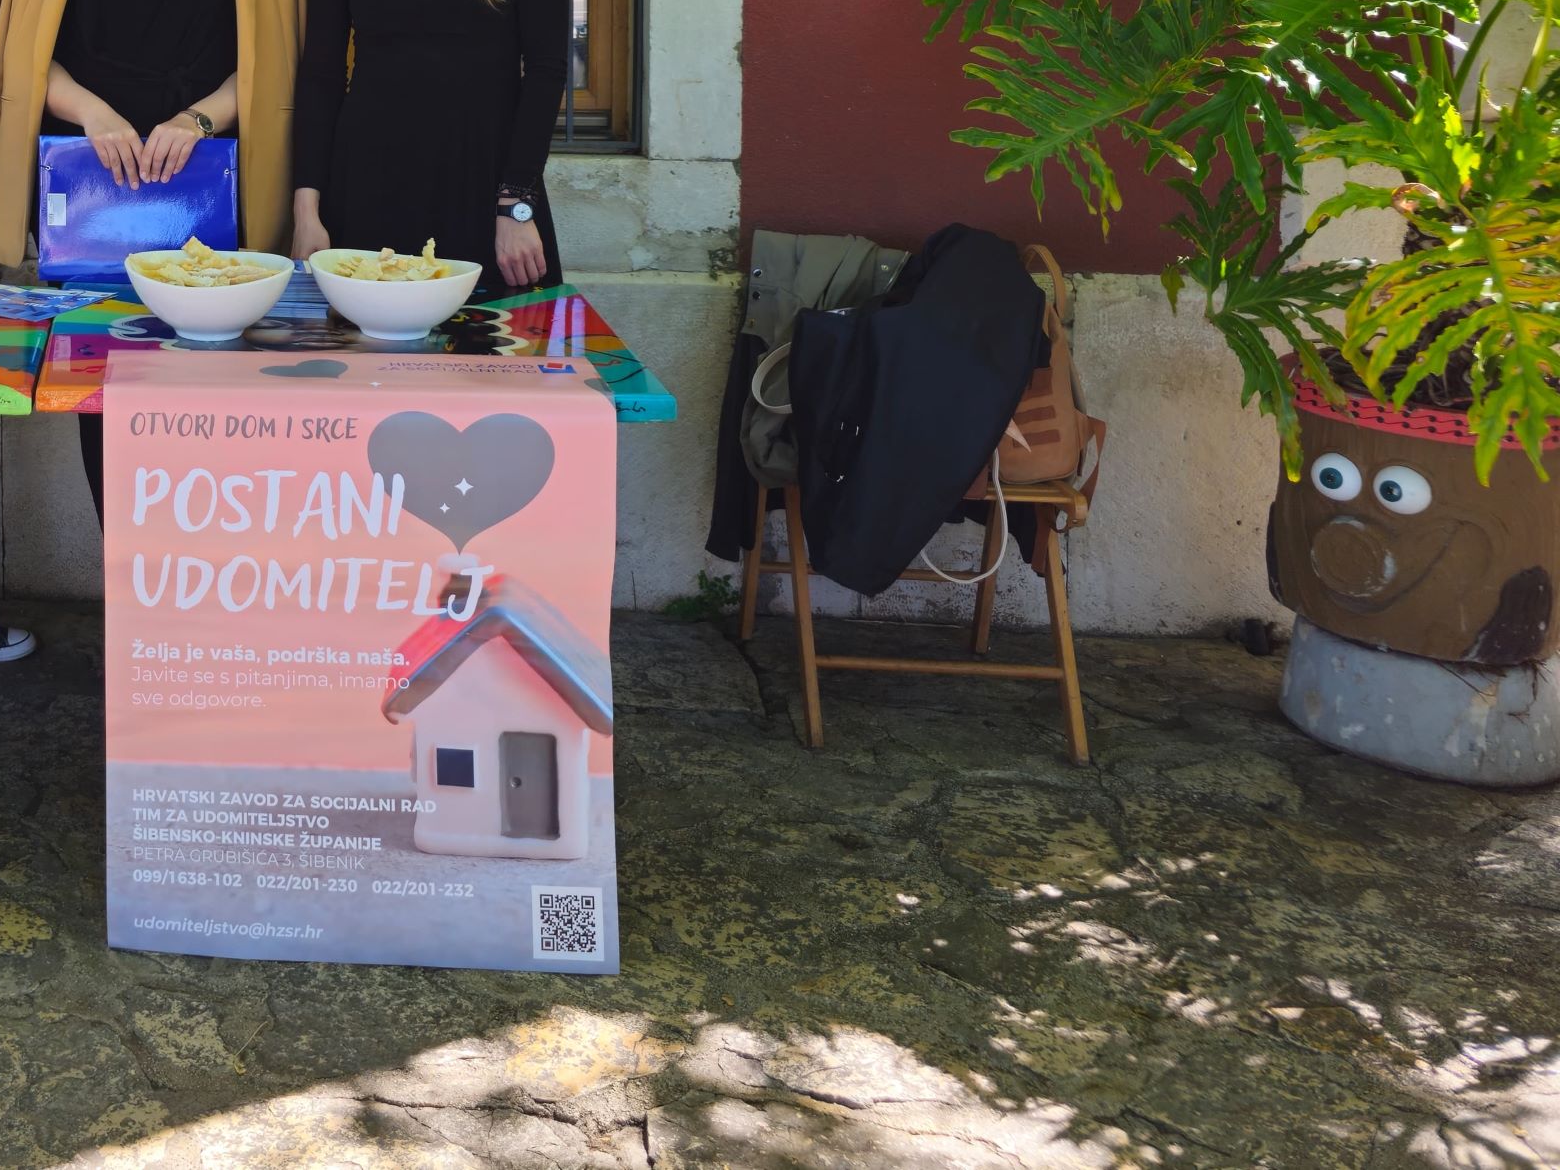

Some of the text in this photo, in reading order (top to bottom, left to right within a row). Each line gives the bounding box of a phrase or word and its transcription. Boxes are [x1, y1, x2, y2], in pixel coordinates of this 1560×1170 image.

[130, 411, 358, 443] OTVORI DOM I SRCE
[132, 467, 405, 540] POSTANI
[132, 553, 495, 622] UDOMITELJ
[132, 639, 411, 669] Želja je vaša, podrška naša.
[132, 666, 411, 693] Javite se s pitanjima, imamo
[132, 689, 267, 712] sve odgovore.
[133, 788, 437, 814] HRVATSKI ZAVOD ZA SOCIJALNI RAD
[133, 808, 330, 829] TIM ZA UDOMITELJSTVO
[133, 826, 382, 851] ŠIBENSKO-KNINSKE ŽUPANIJE
[133, 845, 365, 870] PETRA GRUBIŠIĆA 3, ŠIBENIK
[133, 869, 474, 898] 099/1638-102 022/201-230 022/201-232
[134, 916, 324, 940] udomiteljstvo@hzsr.hr
